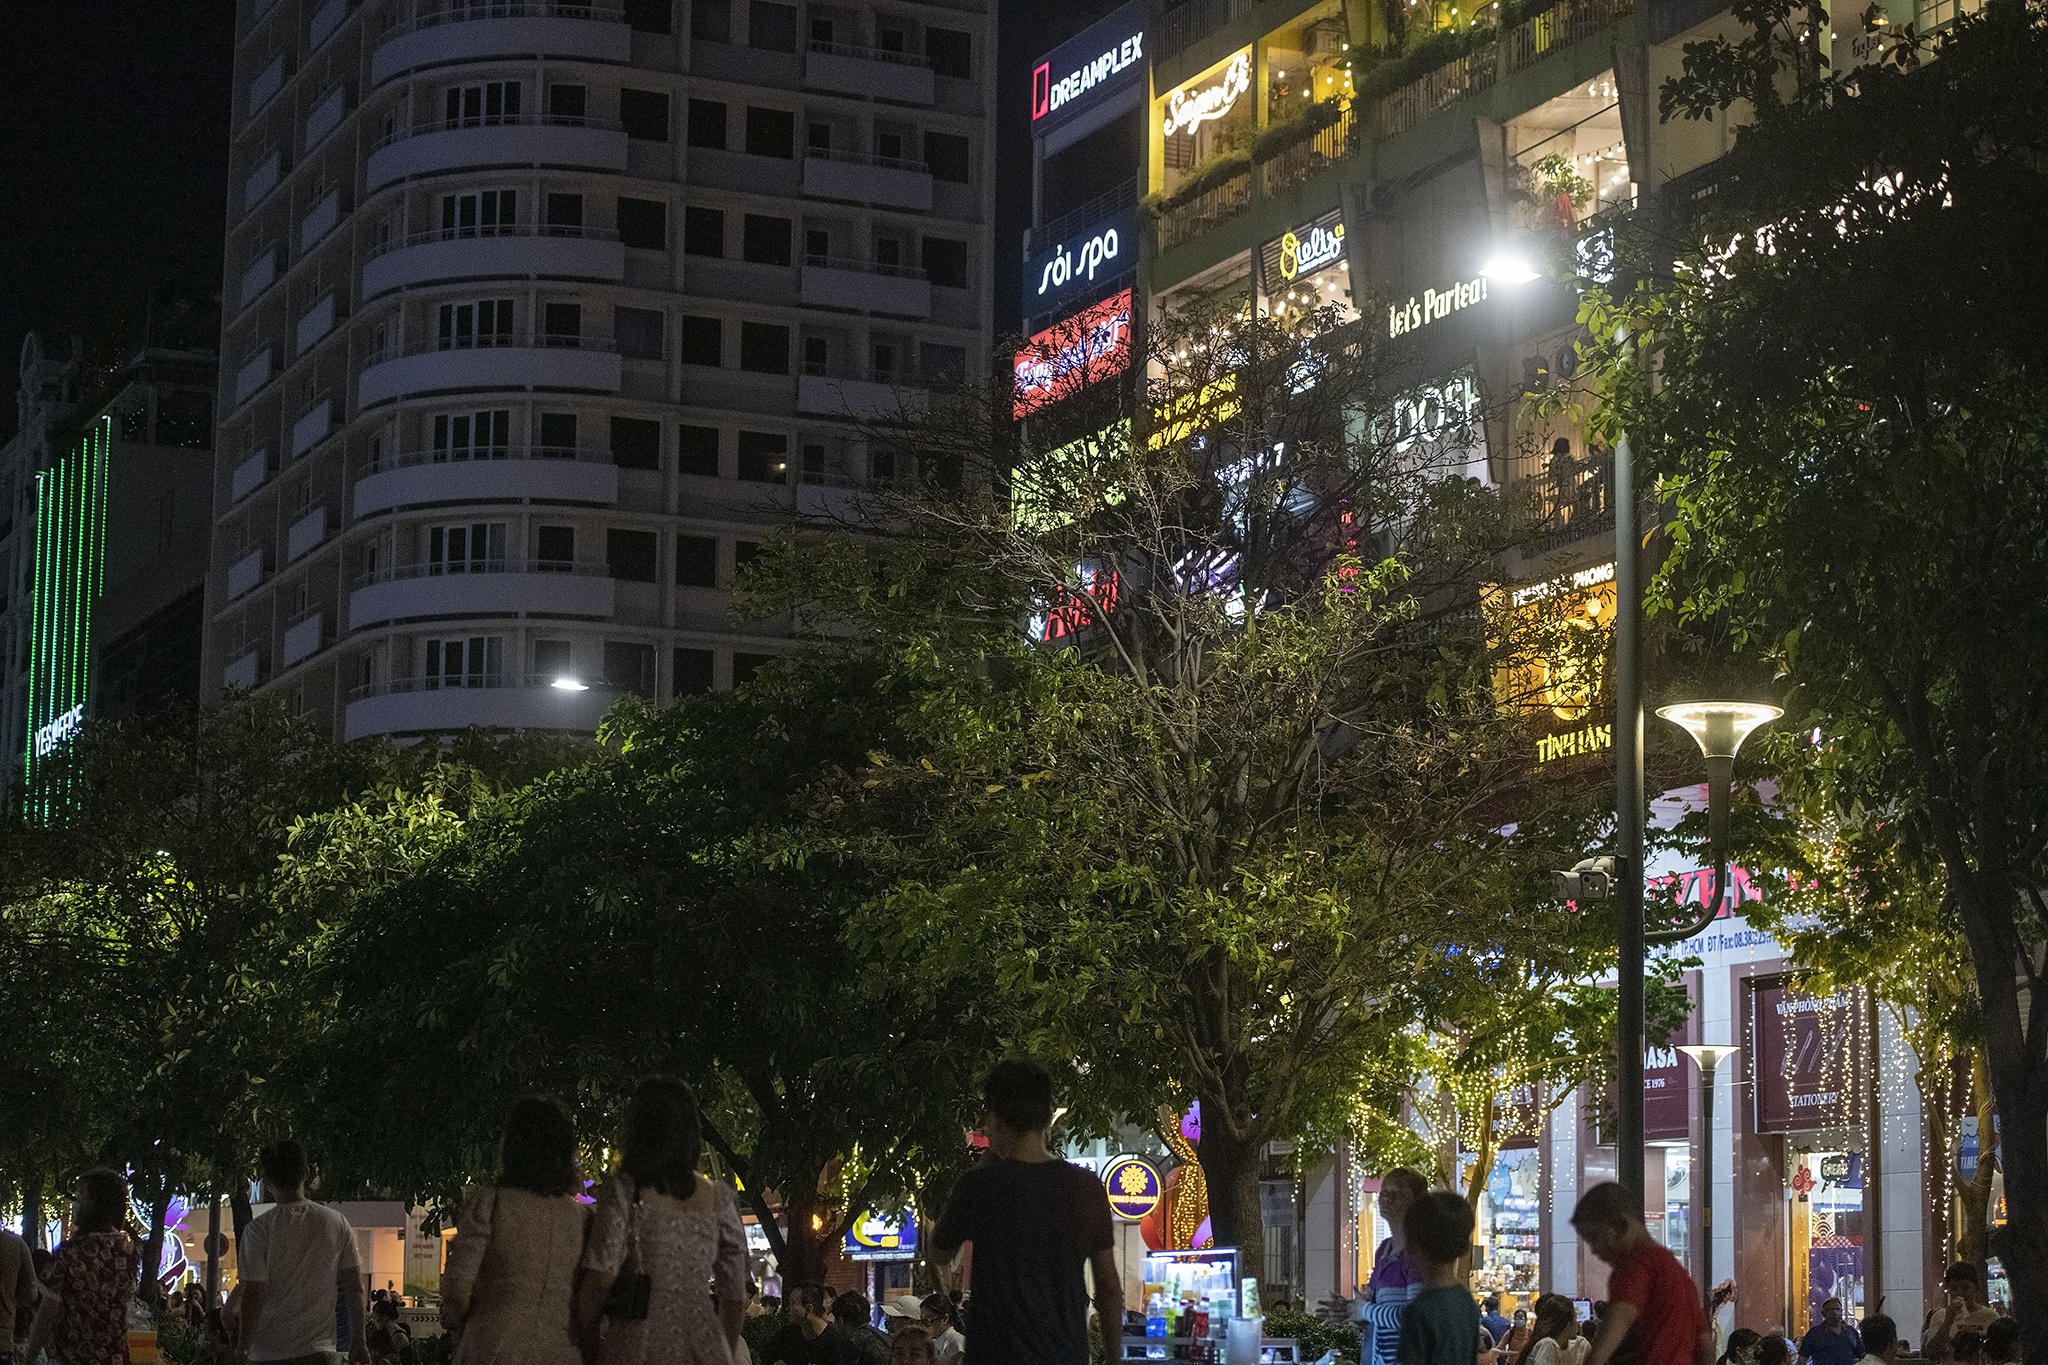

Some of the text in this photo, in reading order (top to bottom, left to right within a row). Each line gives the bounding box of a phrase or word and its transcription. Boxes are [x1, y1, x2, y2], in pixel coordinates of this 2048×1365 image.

[1049, 31, 1144, 112] DREAMPLEX
[1076, 228, 1118, 280] spa
[35, 724, 51, 758] YES
